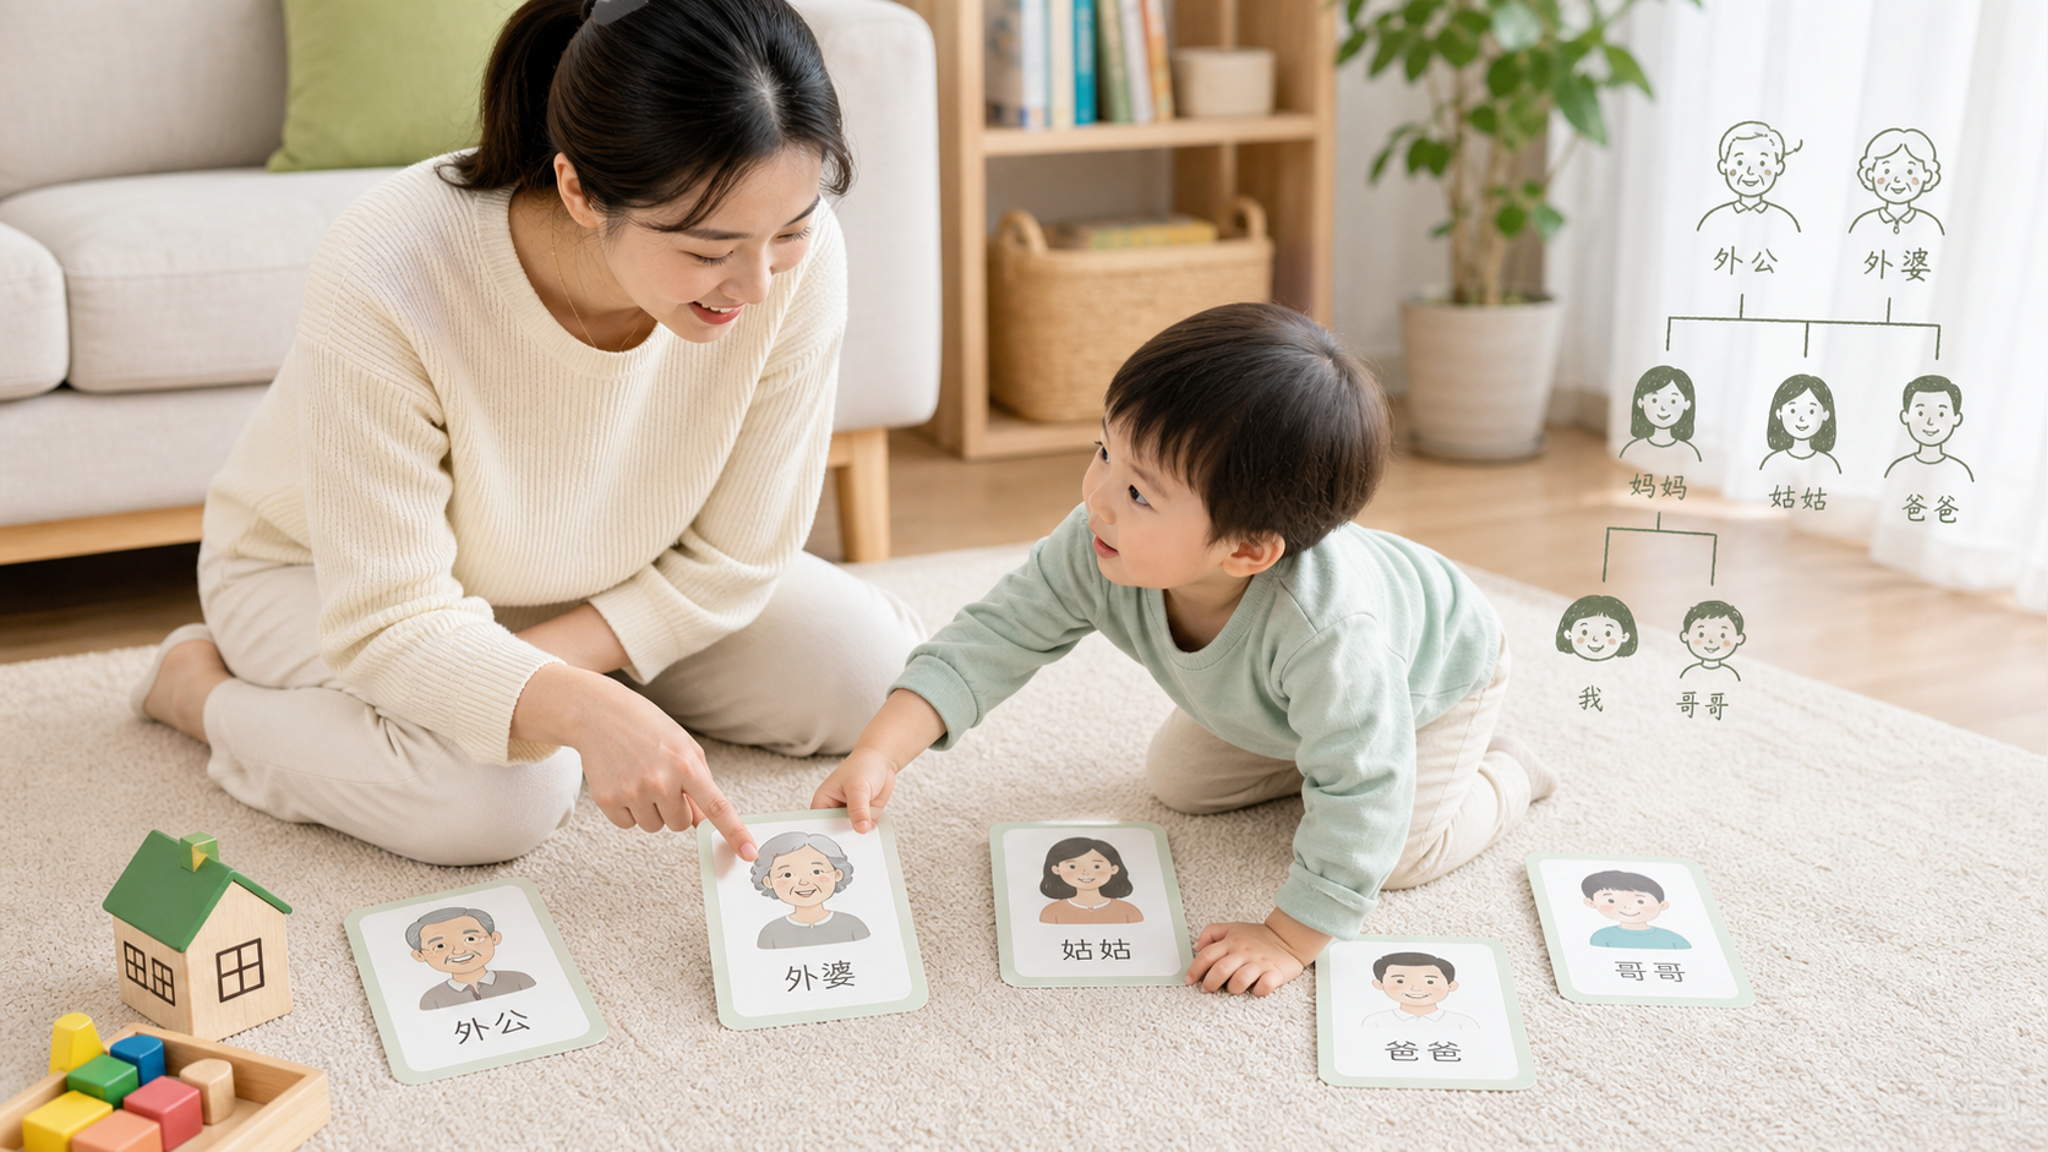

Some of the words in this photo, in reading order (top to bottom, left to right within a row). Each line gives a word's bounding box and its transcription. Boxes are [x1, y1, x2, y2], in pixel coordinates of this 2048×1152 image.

[1061, 938, 1131, 961] 姑姑
[786, 960, 856, 993] 外婆
[1615, 961, 1686, 983] 哥哥
[453, 1009, 530, 1045] 外公
[1385, 1040, 1462, 1063] 爸爸
